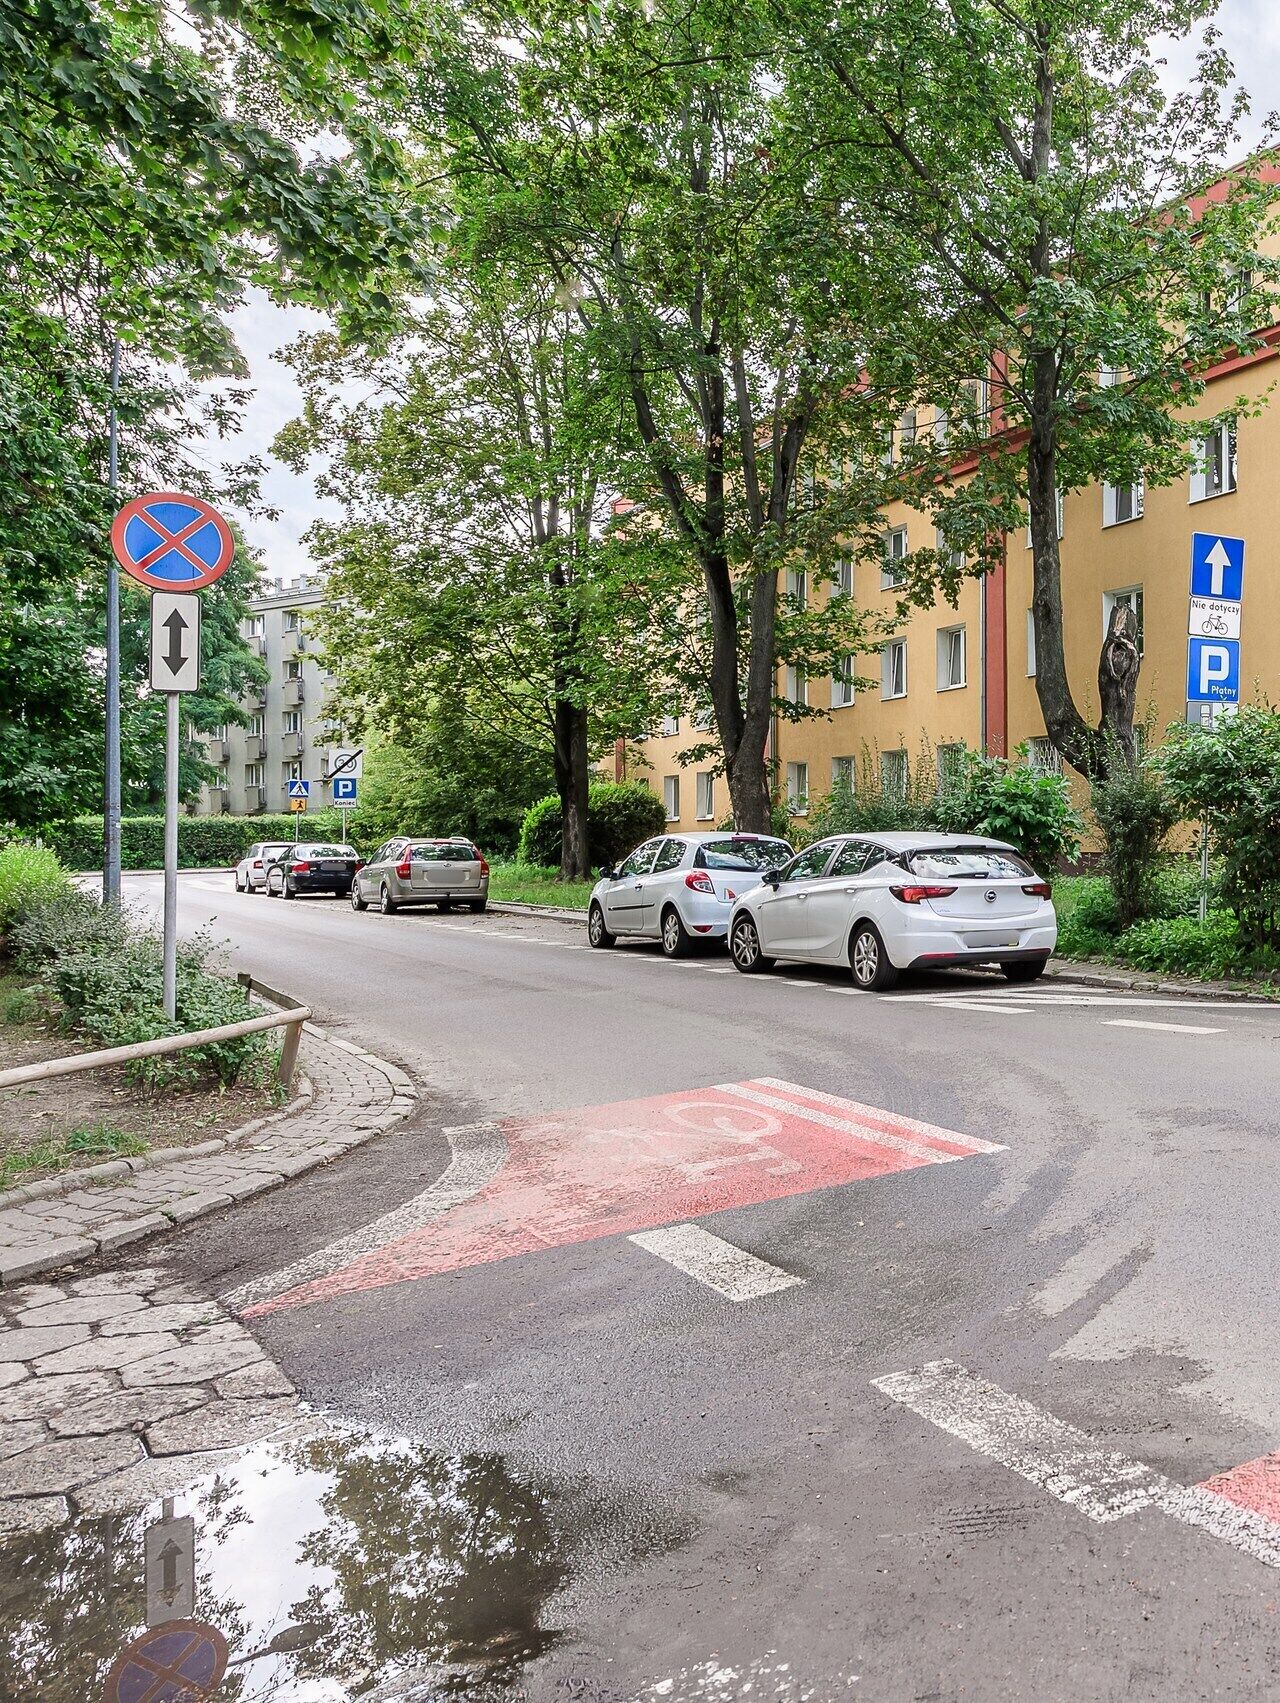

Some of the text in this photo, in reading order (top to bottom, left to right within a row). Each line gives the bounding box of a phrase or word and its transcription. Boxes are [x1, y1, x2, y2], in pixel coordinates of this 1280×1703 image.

[1192, 600, 1240, 615] Nie dotyczy
[1200, 645, 1230, 694] P
[1211, 685, 1237, 697] Płatny
[338, 780, 353, 797] P
